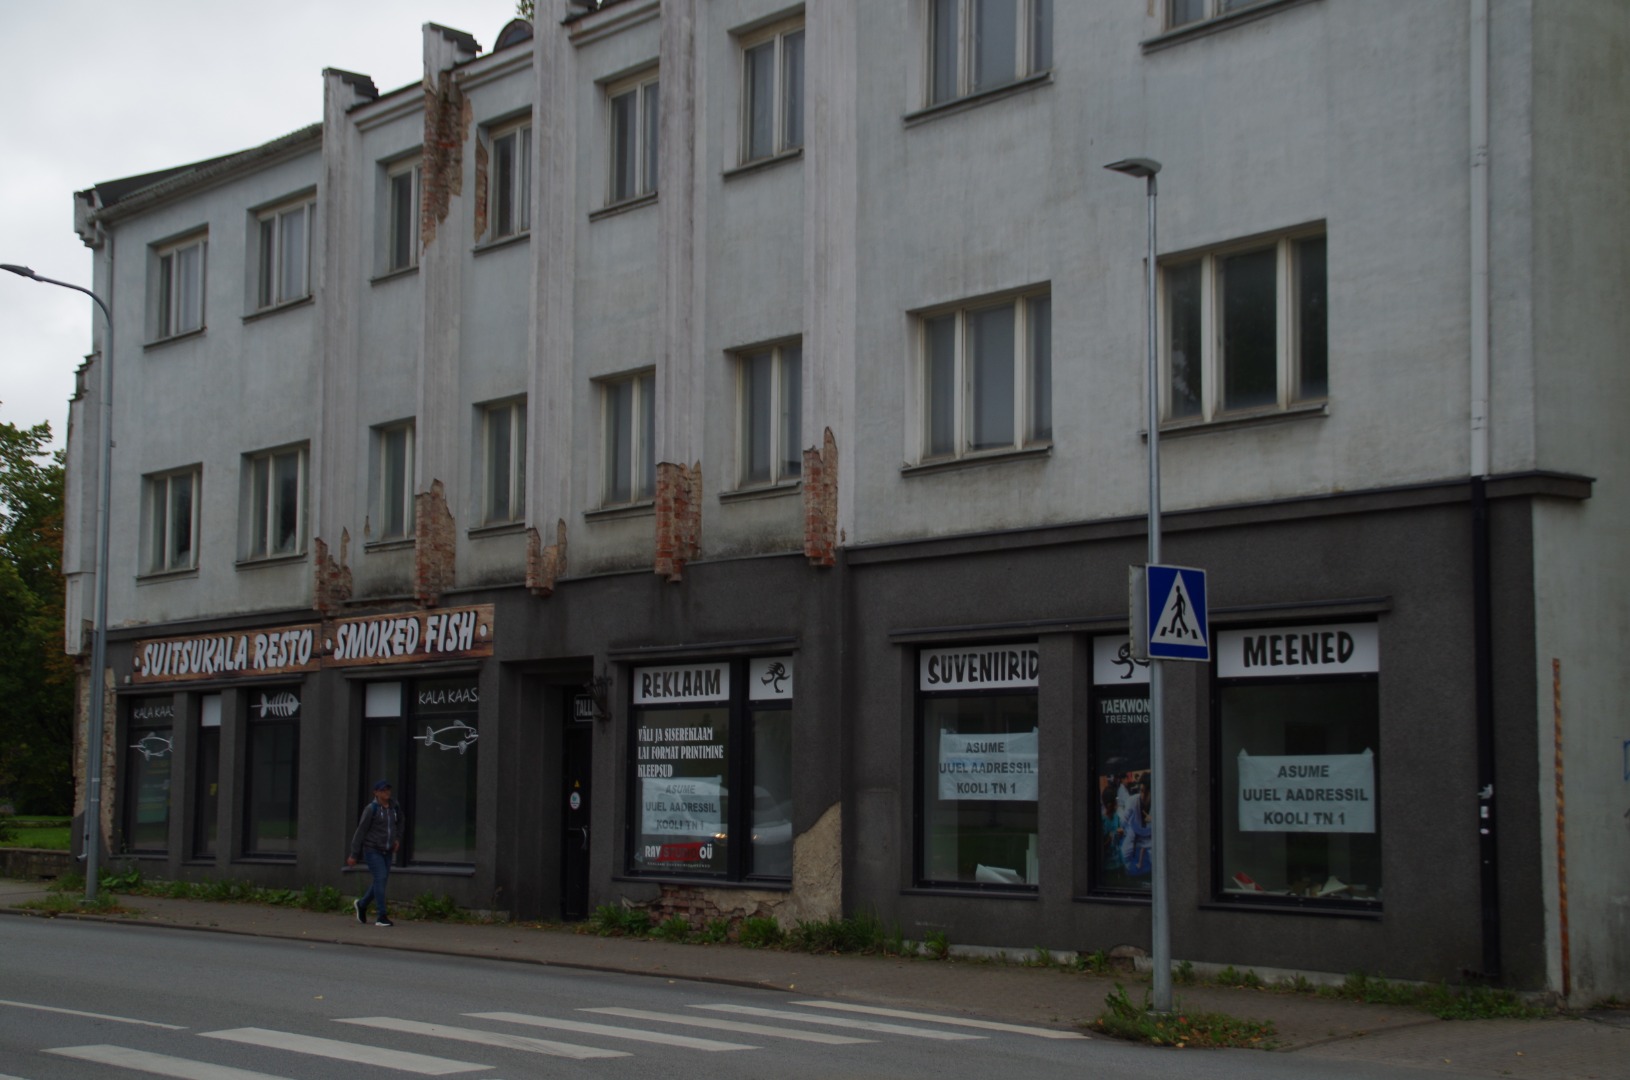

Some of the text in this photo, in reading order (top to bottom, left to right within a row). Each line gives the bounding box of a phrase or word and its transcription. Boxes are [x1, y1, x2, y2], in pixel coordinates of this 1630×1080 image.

[333, 610, 477, 660] SMOKED FISH
[141, 629, 313, 677] SUITSUKALA RESTO
[1243, 631, 1354, 668] MEENED
[928, 650, 1039, 684] SUVENIIRID
[642, 669, 721, 699] REKLAAM
[418, 687, 480, 705] KALA KAAS
[133, 706, 154, 720] KALA
[1104, 714, 1149, 724] TREENING
[638, 726, 714, 744] VÄLI JA SISEREKLAAM
[638, 745, 724, 760] LAI FORMAT PRINTIMINE
[966, 741, 1005, 753] ASUME
[637, 764, 673, 778] KLEEPSUD
[939, 762, 1034, 774] UUEL AADRESSIL
[1277, 765, 1330, 778] ASUME
[665, 784, 696, 794] ASUME
[957, 783, 1016, 794] KOOLI TN 1
[1243, 788, 1369, 801] UUEL AADRESSIL
[645, 801, 717, 813] UUEL AADRESSIL
[656, 819, 683, 830] KOOLI
[685, 820, 698, 831] TN
[1264, 812, 1345, 825] KOOLI TN 1
[645, 845, 662, 857] RAY
[698, 843, 713, 859] OÜ
